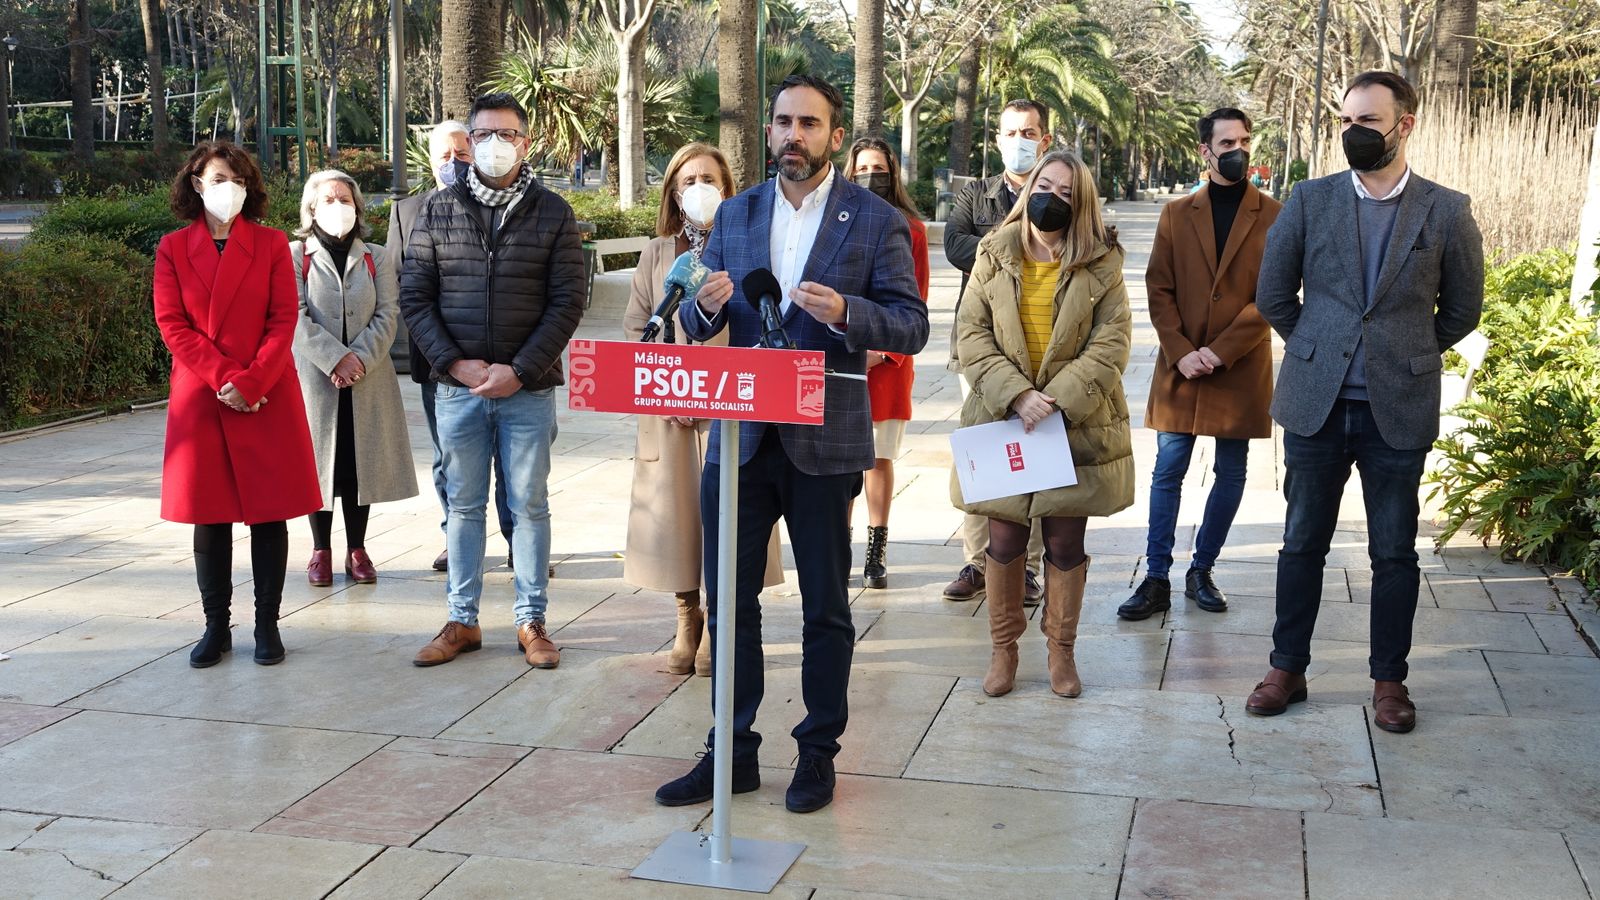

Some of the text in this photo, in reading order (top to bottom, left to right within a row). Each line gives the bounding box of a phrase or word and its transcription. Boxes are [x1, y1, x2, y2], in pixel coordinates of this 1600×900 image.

[634, 351, 682, 368] Málaga
[570, 340, 596, 412] PSOE
[634, 367, 709, 399] PSOE
[634, 397, 755, 412] GRUPO MUNICIPAL SOCIALISTA
